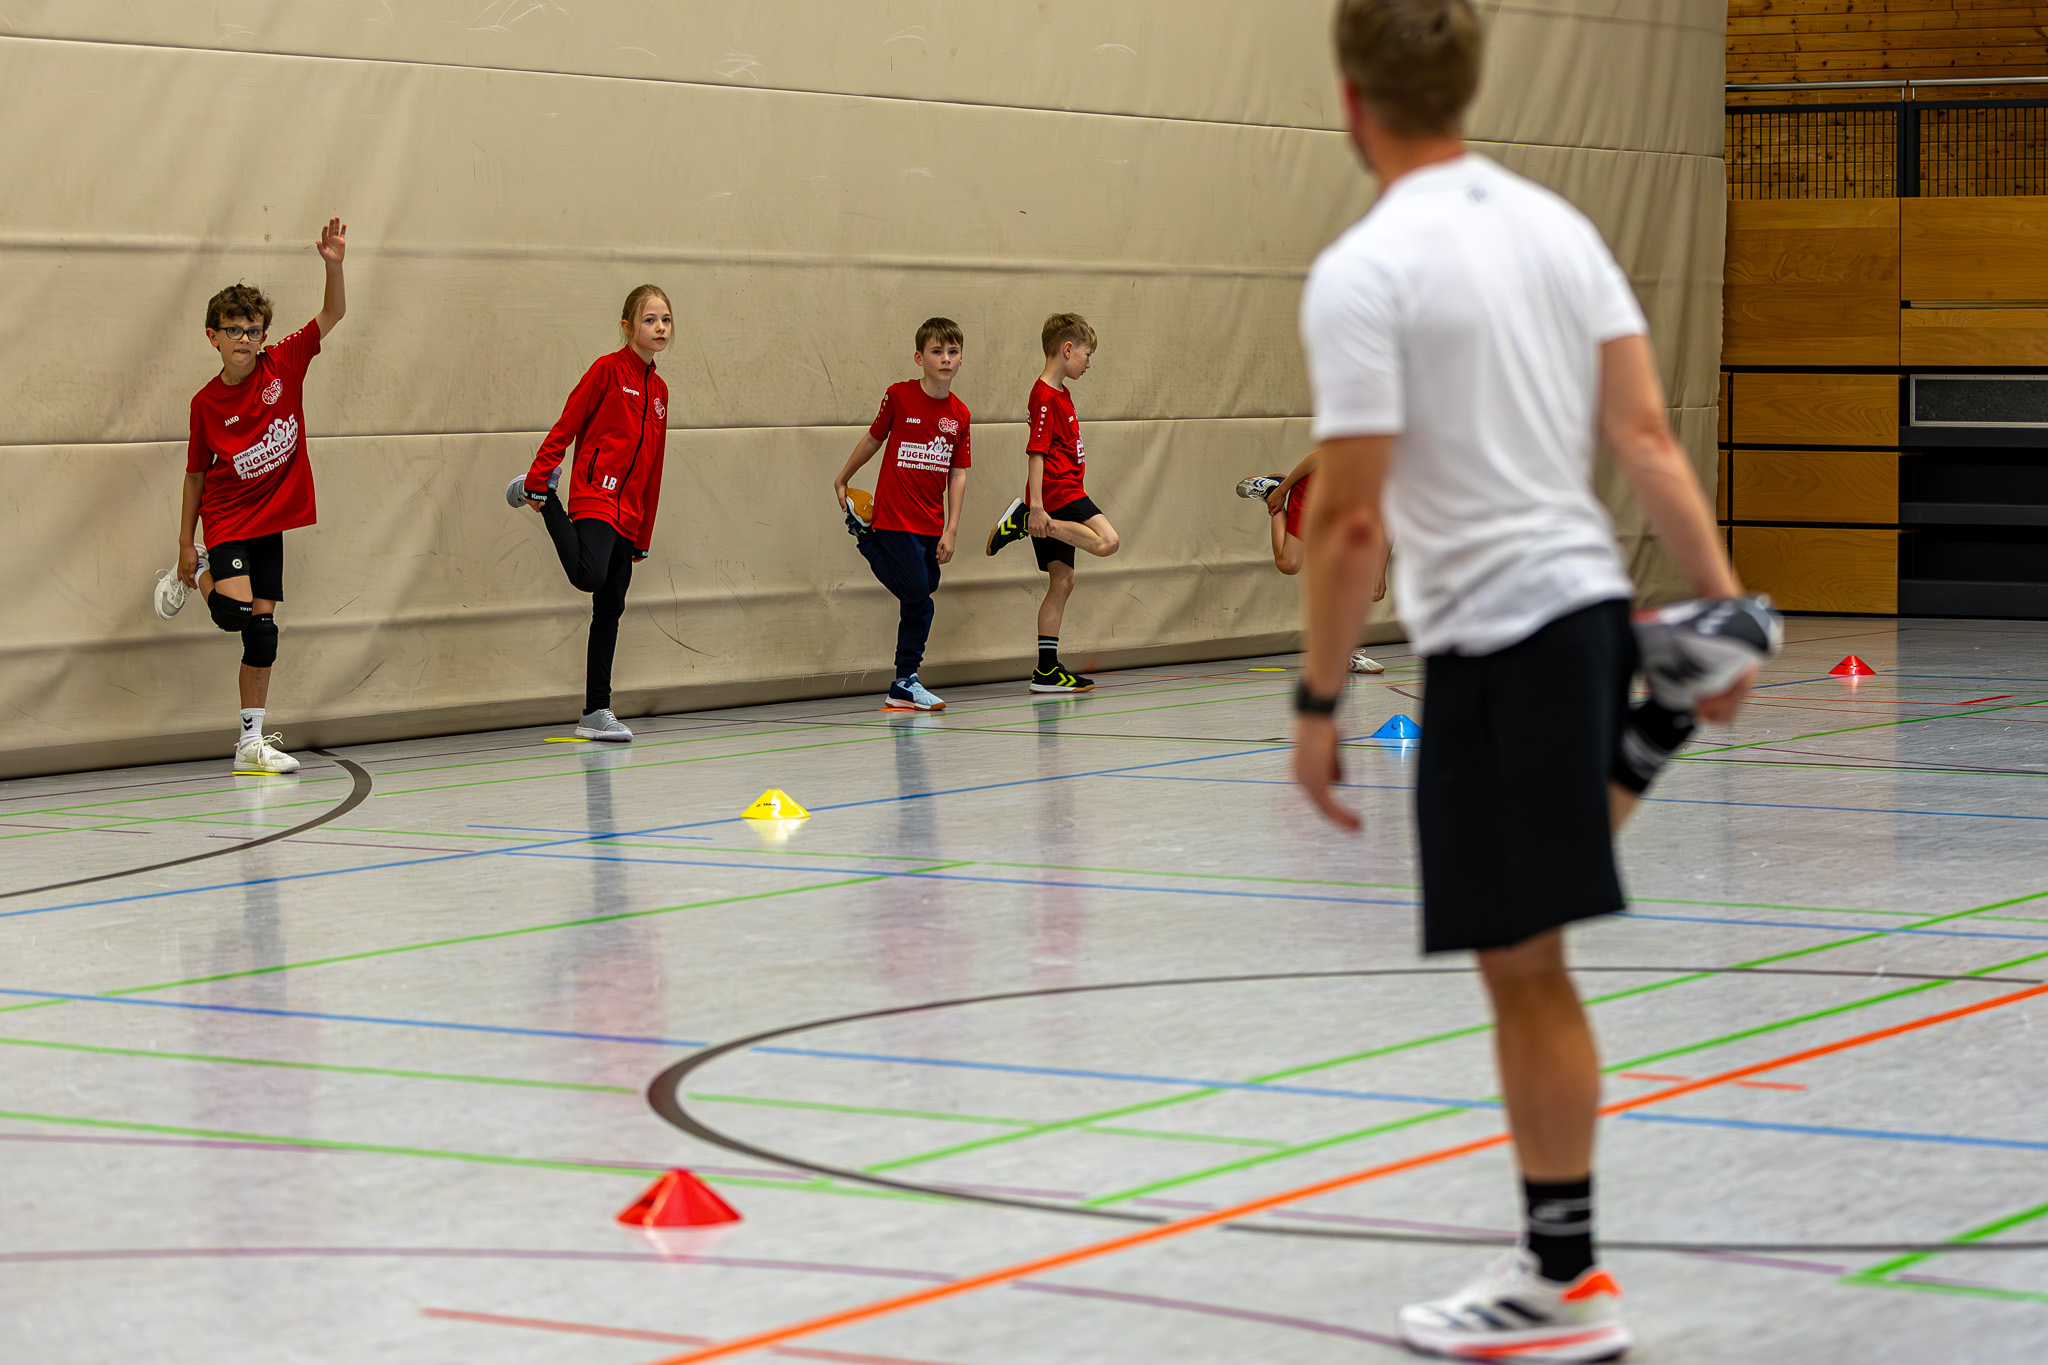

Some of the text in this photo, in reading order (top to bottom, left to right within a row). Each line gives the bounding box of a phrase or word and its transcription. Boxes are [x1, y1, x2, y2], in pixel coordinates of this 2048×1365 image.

[623, 386, 640, 396] Kempa
[225, 415, 240, 427] JAKO
[234, 444, 265, 462] HANDBALL
[901, 443, 926, 451] HANDBALL
[900, 450, 950, 463] JUGENDCAM
[602, 475, 617, 490] LB
[531, 492, 548, 501] Kemp
